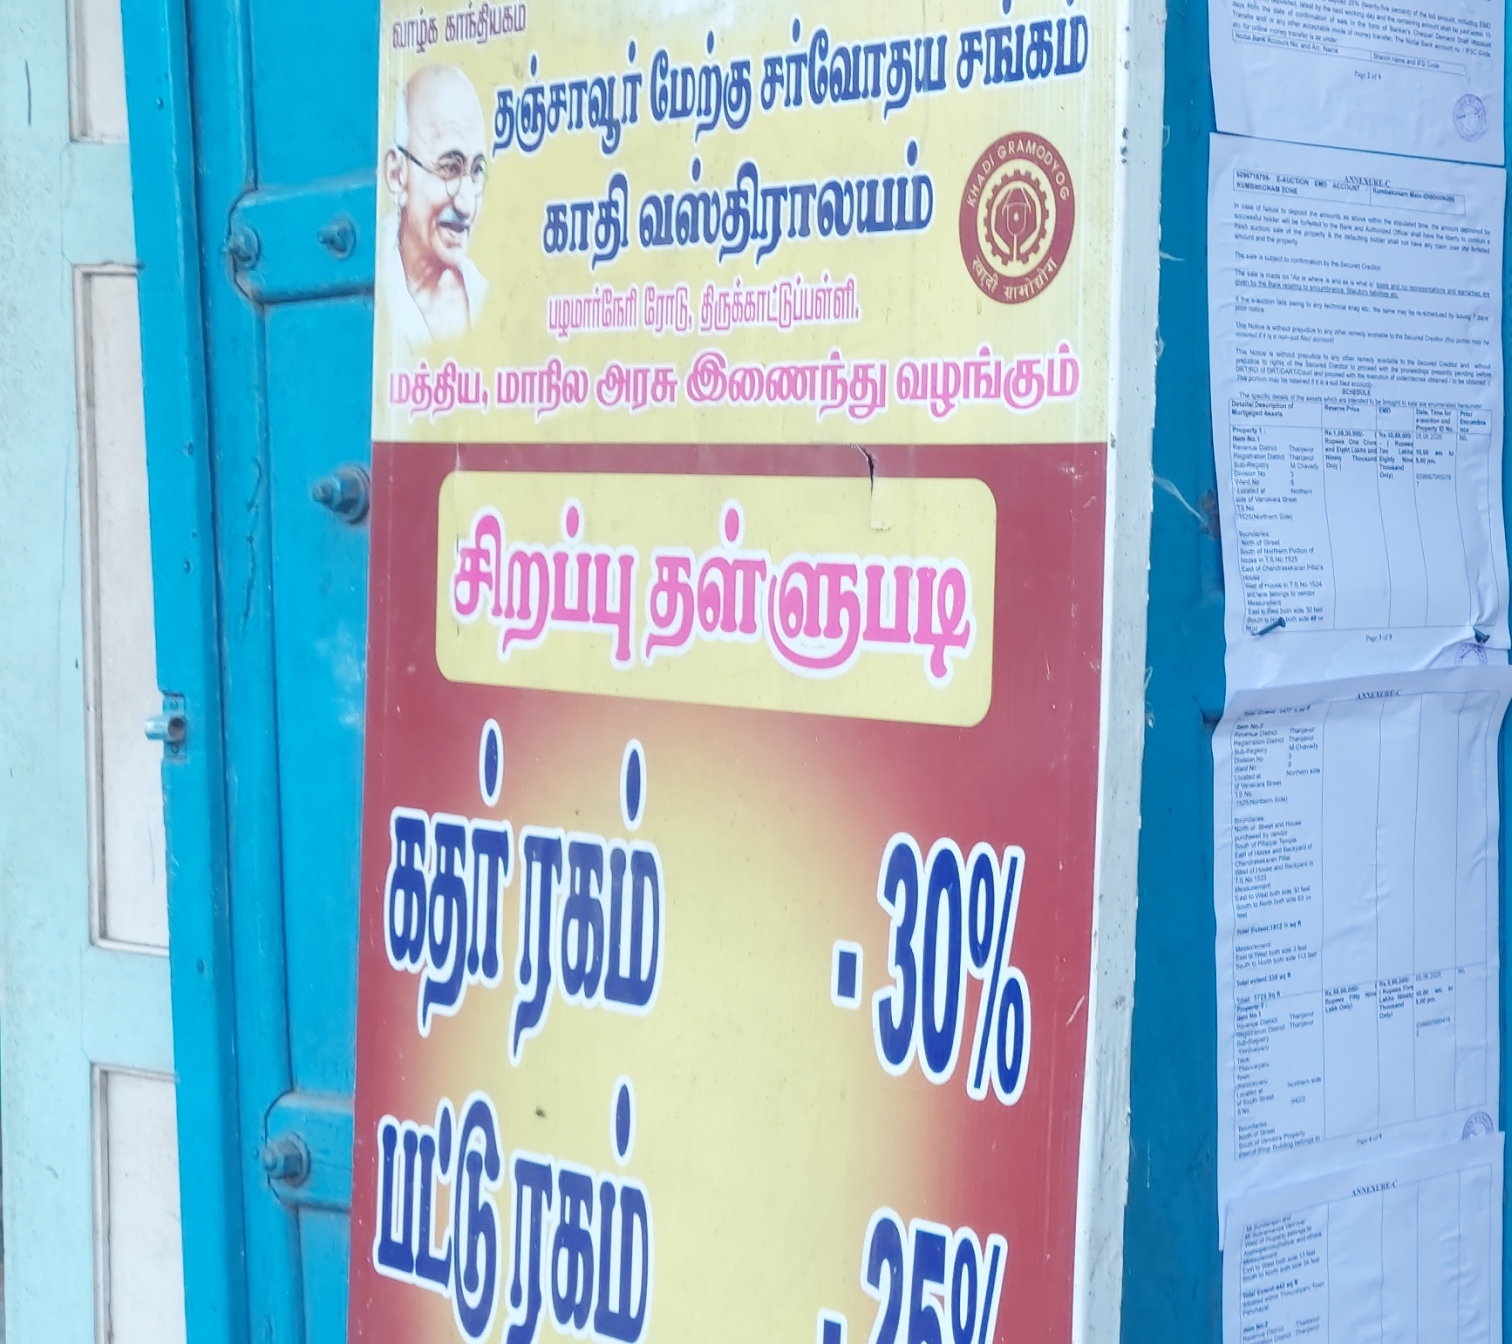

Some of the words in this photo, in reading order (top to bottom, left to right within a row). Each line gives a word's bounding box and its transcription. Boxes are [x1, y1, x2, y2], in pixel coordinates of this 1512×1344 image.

[392, 7, 438, 53] வாழ்க
[492, 39, 643, 157] தஞ்சாவூர்
[651, 30, 752, 143] மேற்கு
[761, 18, 947, 122] சர்வோதய
[543, 173, 629, 271] காதி
[639, 140, 934, 265] வஸ்திராலயம்
[966, 154, 995, 209] KHADI
[997, 139, 1070, 201] GRAMODYOG
[643, 285, 692, 333] ரோடு,
[388, 360, 489, 415] மத்திய,
[496, 359, 589, 414] மாநில
[596, 364, 678, 410] அரசு
[686, 350, 885, 421] இணைந்து
[895, 341, 1081, 416] வழங்கும்
[453, 505, 635, 663] சிறப்பு
[646, 505, 972, 679] தள்ளுபடி
[388, 727, 512, 1031] கதர்
[515, 747, 663, 1057] ரகம்
[377, 1101, 500, 1342] பட்டு
